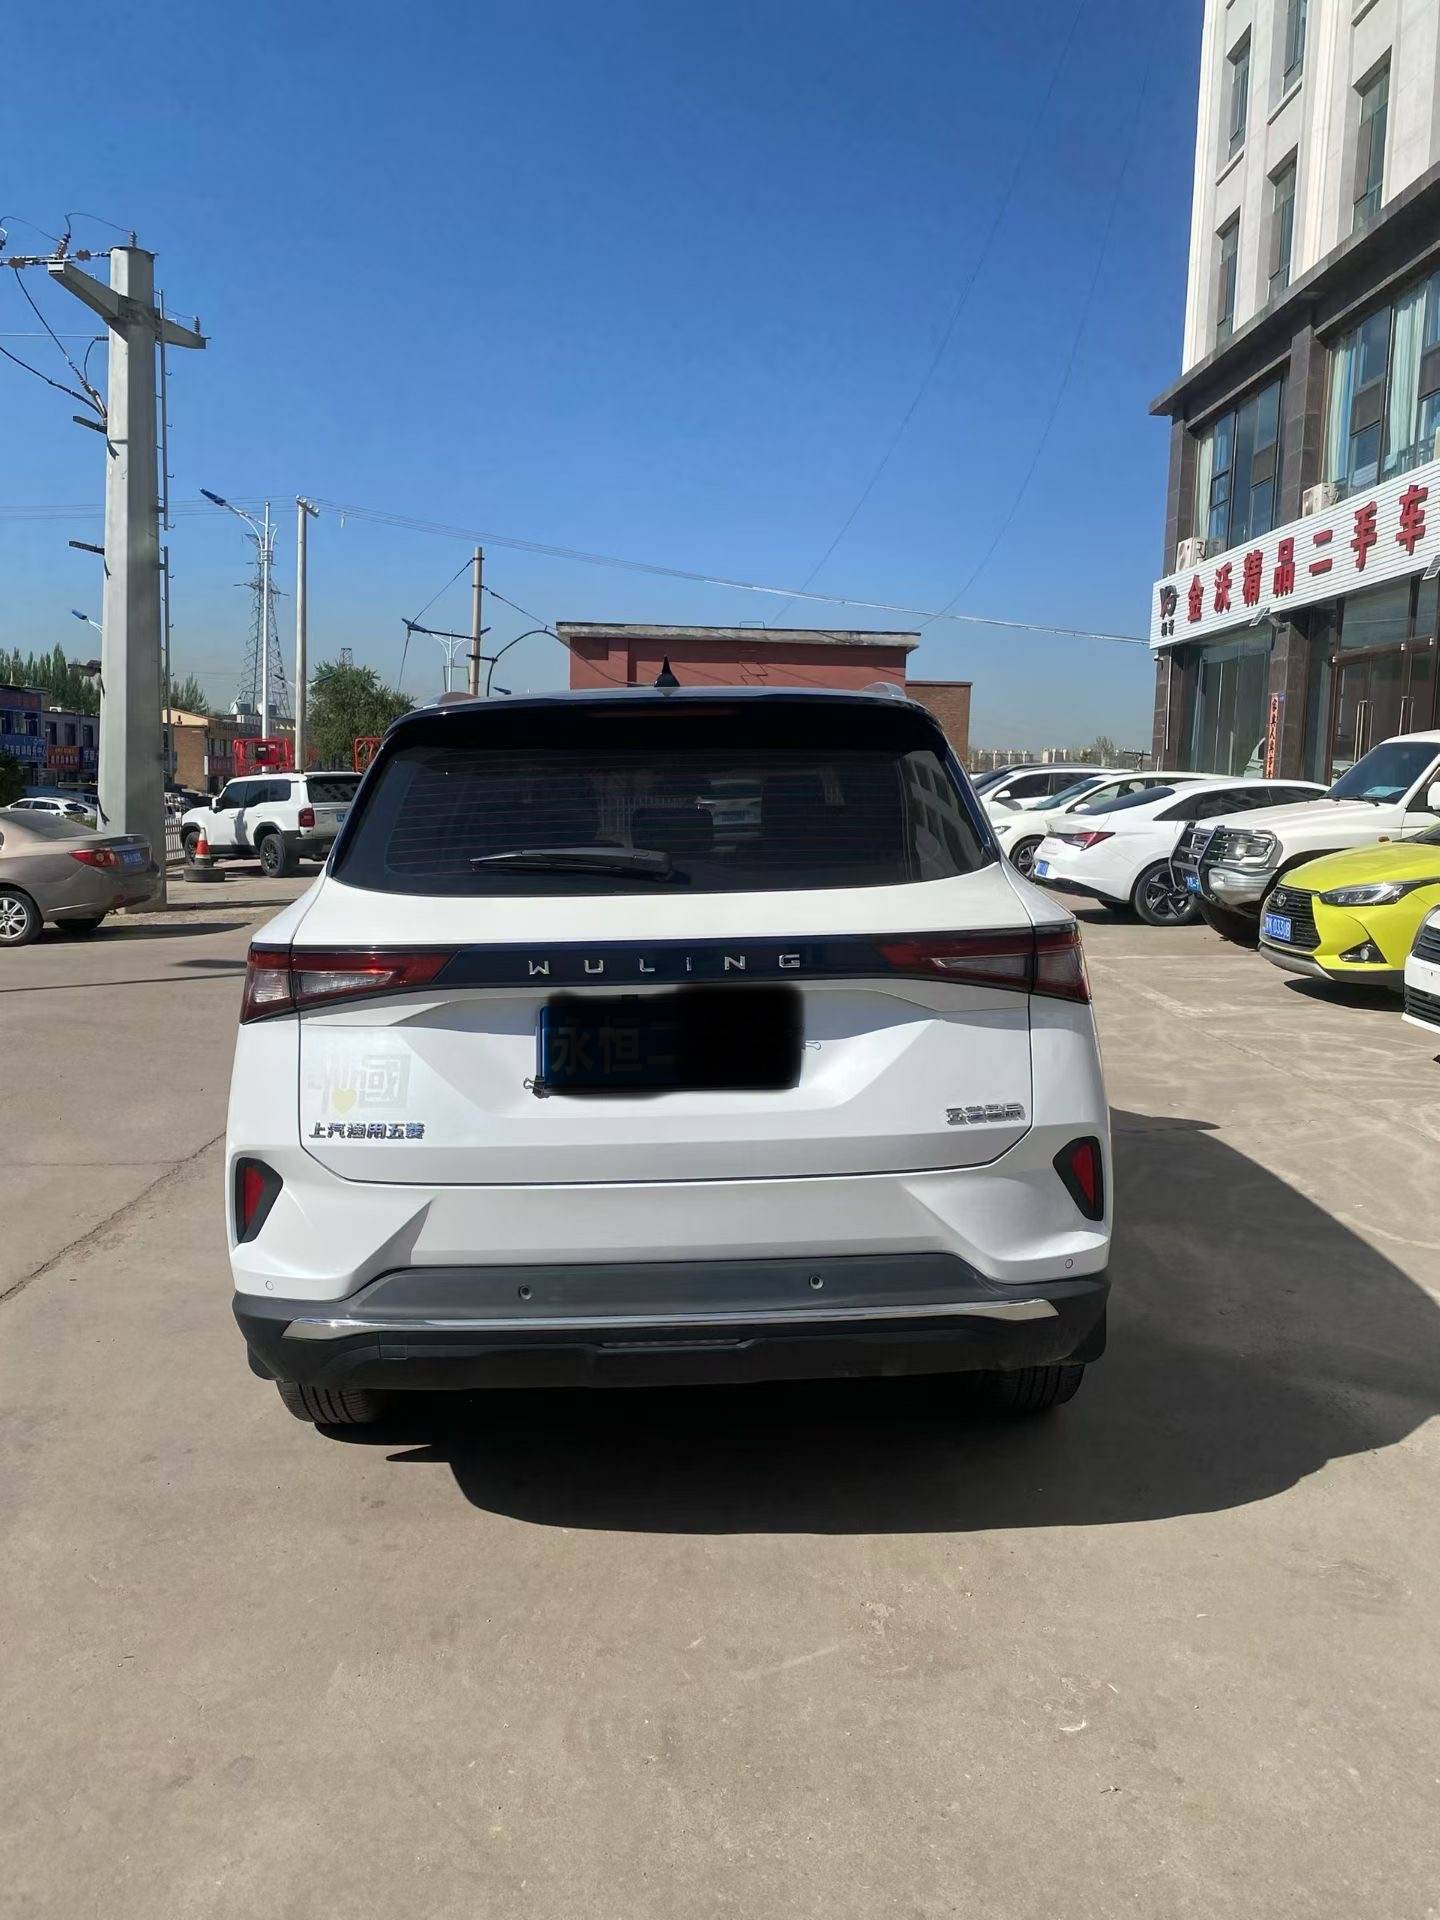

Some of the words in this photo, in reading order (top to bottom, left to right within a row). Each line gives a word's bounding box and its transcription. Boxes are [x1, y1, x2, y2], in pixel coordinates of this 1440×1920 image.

[1187, 484, 1428, 624] 金沃精品二手车
[528, 953, 800, 975] WULING
[308, 1122, 425, 1140] 上汽通用五菱
